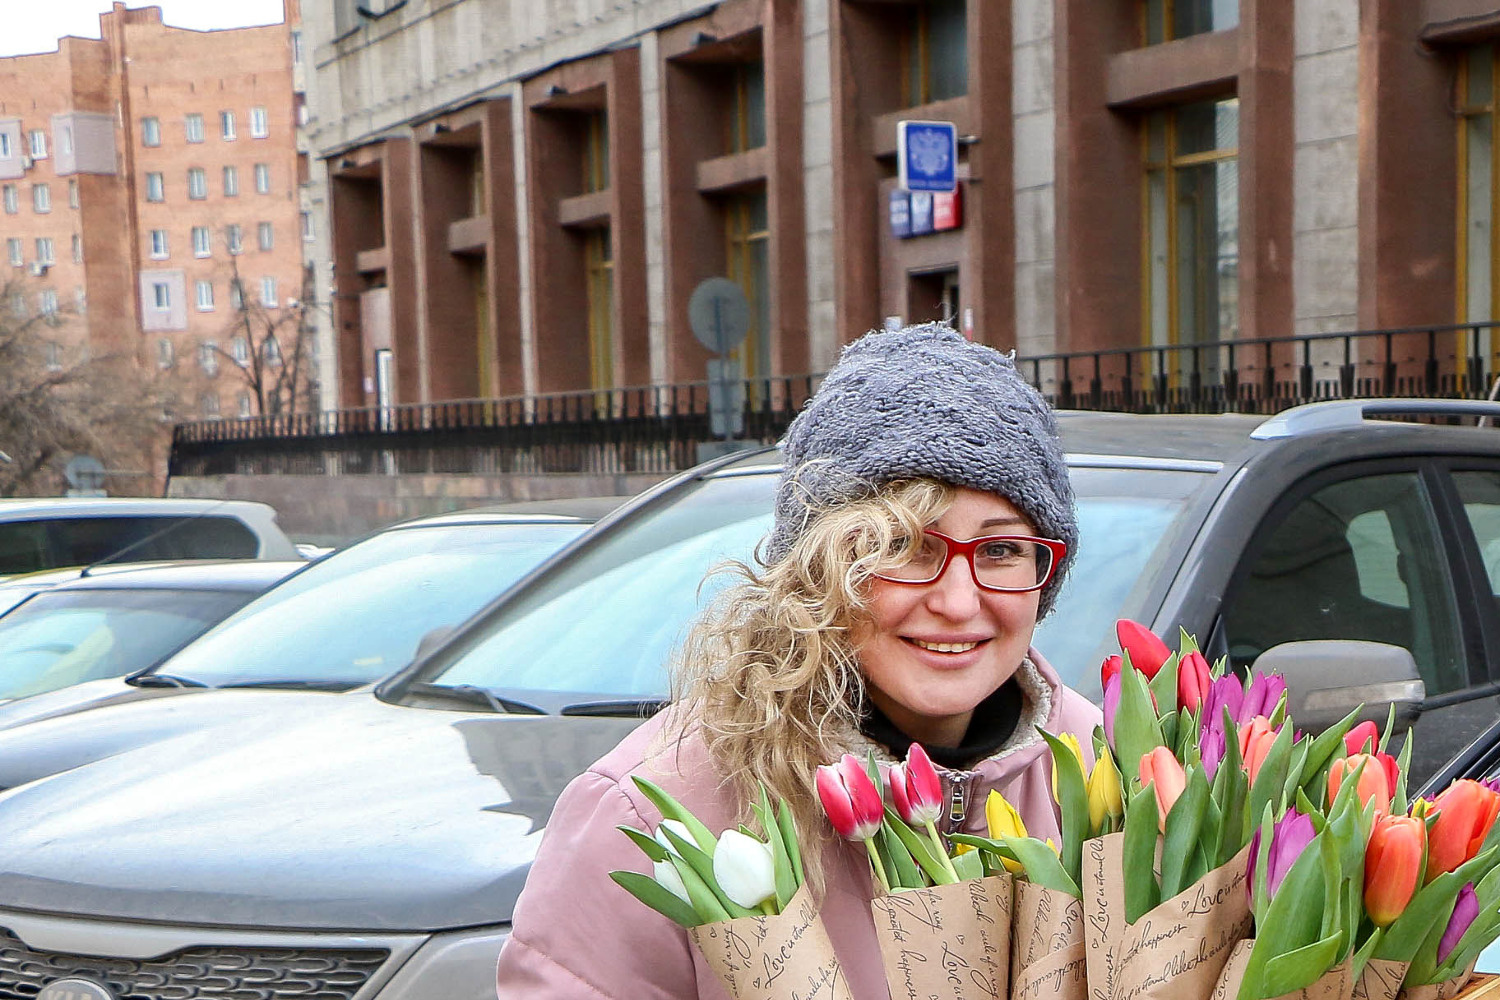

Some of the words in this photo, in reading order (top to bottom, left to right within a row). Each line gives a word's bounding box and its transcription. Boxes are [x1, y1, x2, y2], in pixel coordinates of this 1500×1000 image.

[1089, 898, 1110, 943] Love
[1139, 921, 1187, 949] happiness
[1187, 884, 1223, 918] Love
[763, 946, 791, 989] Love
[785, 940, 795, 949] is
[940, 941, 969, 985] Love
[954, 986, 961, 996] is
